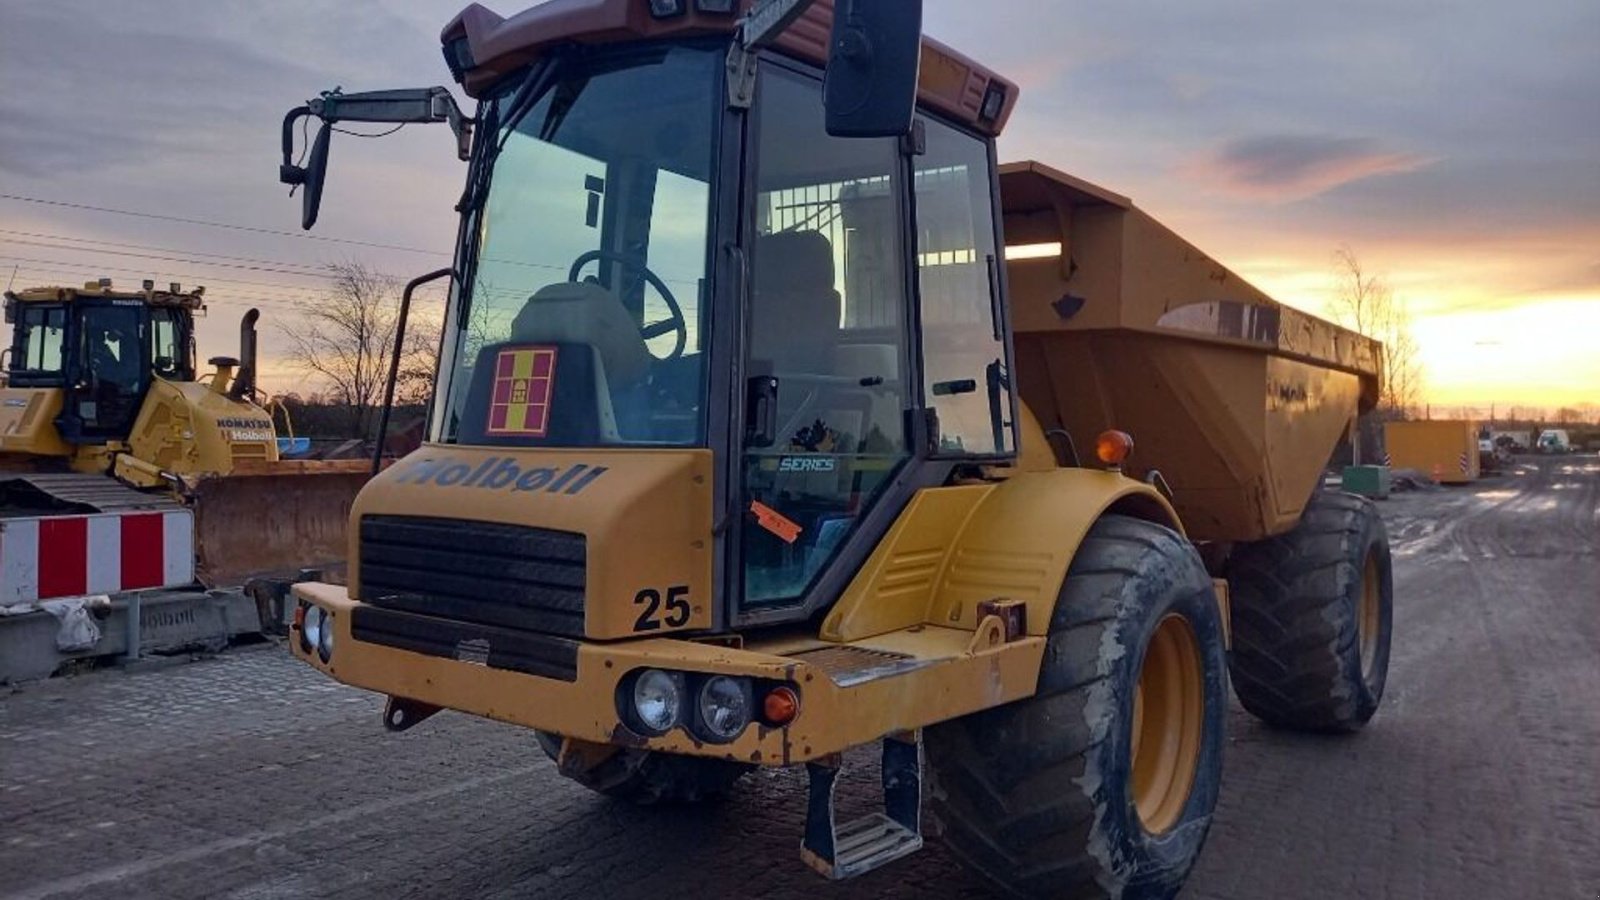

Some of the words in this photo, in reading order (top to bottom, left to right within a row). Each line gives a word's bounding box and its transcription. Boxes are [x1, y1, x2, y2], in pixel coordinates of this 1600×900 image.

[216, 417, 271, 429] KOMATSU
[779, 457, 835, 471] SERIES
[633, 585, 691, 632] 25
